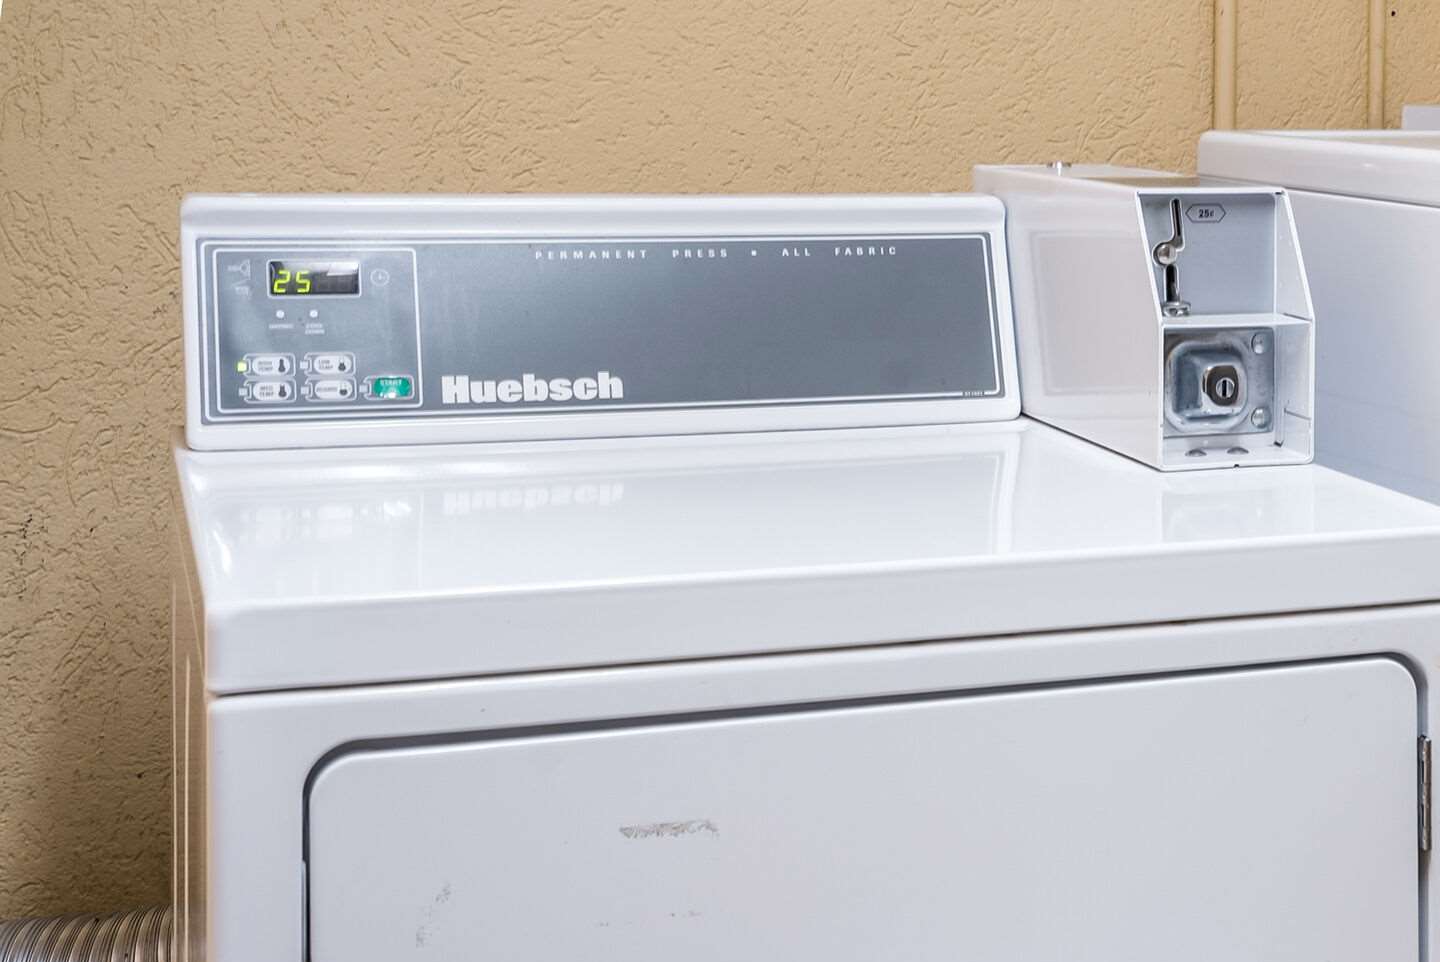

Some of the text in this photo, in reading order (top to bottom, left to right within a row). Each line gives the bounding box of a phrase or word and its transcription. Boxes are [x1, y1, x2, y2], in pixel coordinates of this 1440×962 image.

[536, 247, 896, 260] PERMANENT PRESS ALL FABRIC
[274, 270, 311, 292] 25
[442, 371, 623, 404] Huebsch
